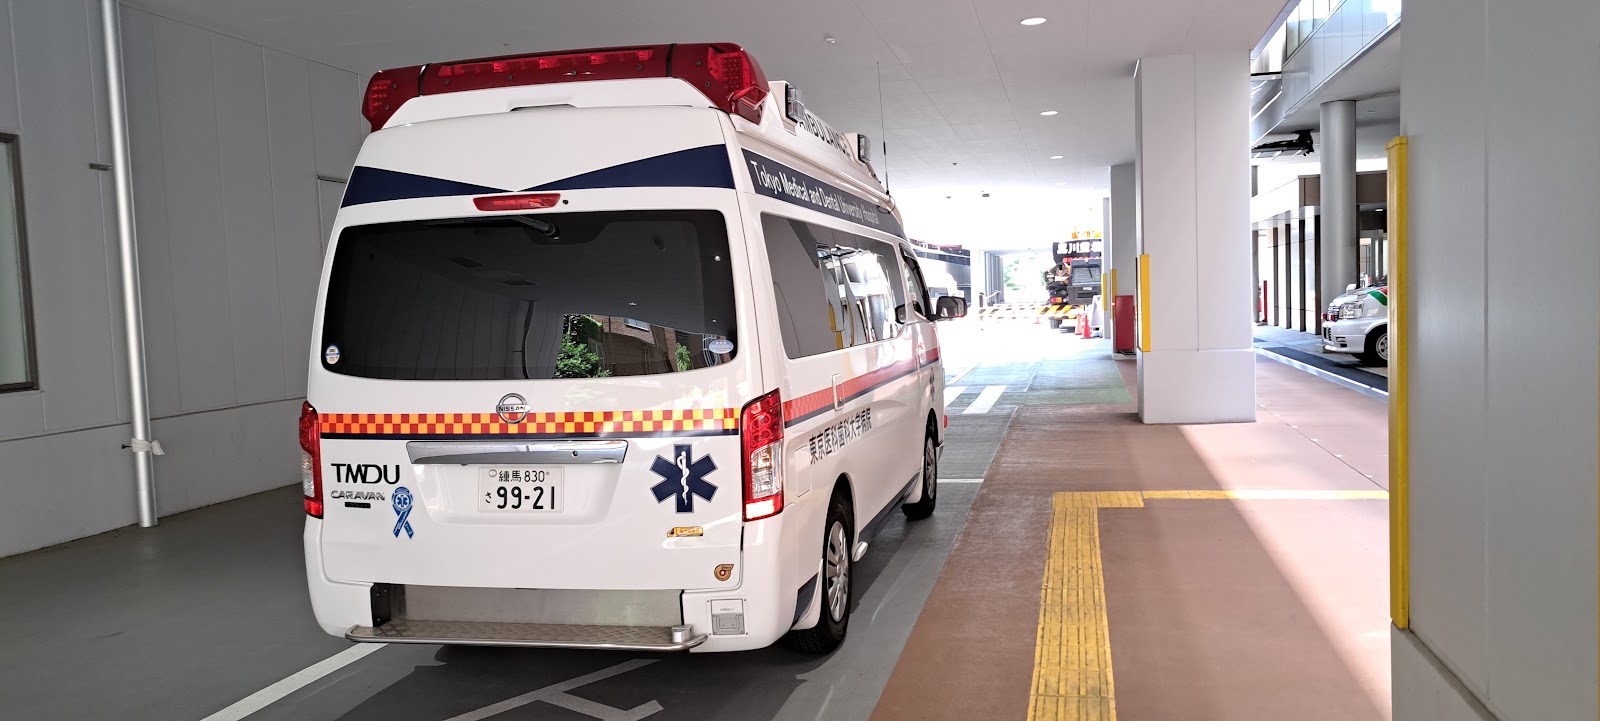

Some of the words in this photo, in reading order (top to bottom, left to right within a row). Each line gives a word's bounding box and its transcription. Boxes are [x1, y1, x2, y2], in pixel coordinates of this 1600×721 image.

[750, 160, 782, 195] Tokyo
[779, 171, 811, 202] Medical
[809, 186, 823, 206] and
[819, 188, 841, 212] Dental
[837, 195, 865, 223] University
[861, 204, 880, 226] Hospital
[808, 406, 872, 465] 東京医科歯科大学病院
[330, 463, 401, 485] TMDU
[498, 470, 522, 482] 練馬
[524, 470, 545, 482] 830
[330, 490, 386, 501] CARAVAN
[496, 486, 555, 510] 99-21
